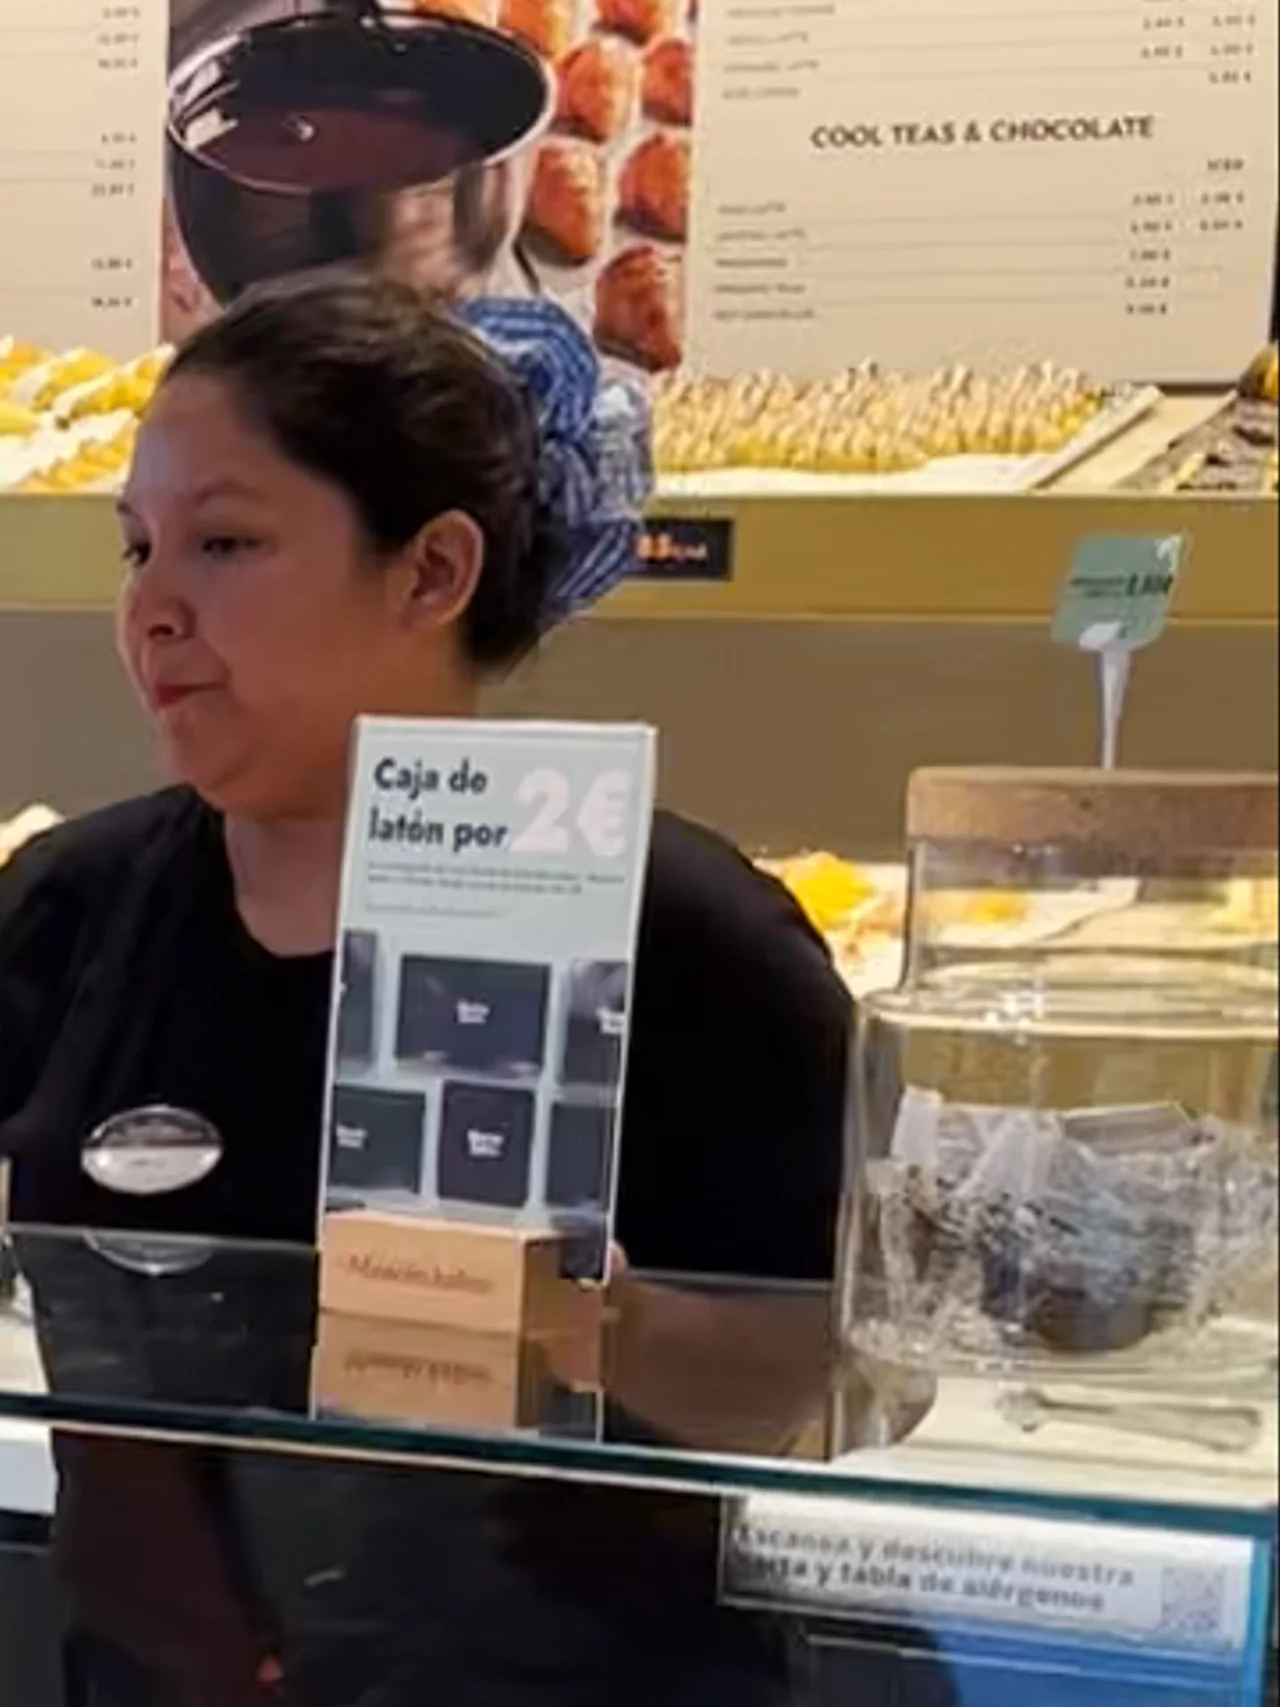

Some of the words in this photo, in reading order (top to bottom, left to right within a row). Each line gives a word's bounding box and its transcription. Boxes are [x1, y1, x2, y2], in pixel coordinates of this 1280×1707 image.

[809, 124, 883, 150] COOL
[891, 121, 957, 146] TEAS
[963, 121, 982, 145] &
[988, 115, 1155, 143] CHOCOLATE
[373, 756, 440, 801] Caja
[448, 756, 488, 795] de
[368, 805, 445, 846] latón
[453, 822, 509, 854] por
[512, 766, 634, 858] 2€
[814, 1560, 833, 1588] y
[840, 1561, 912, 1590] tabla
[1021, 1556, 1135, 1587] nuestra
